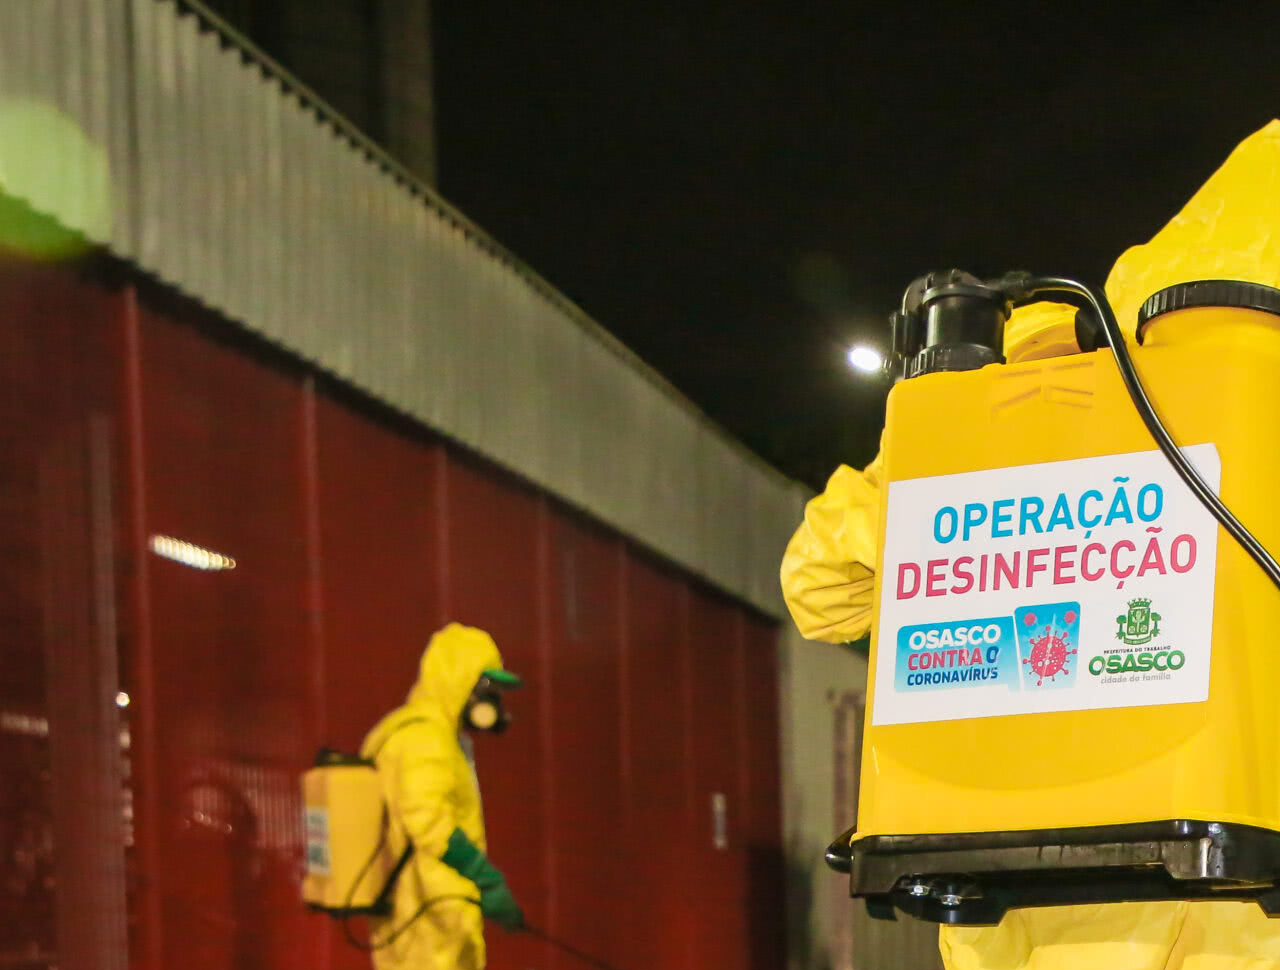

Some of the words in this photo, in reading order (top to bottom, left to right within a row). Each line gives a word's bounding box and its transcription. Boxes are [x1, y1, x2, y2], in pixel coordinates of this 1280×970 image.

[933, 476, 1164, 544] OPERAÇÃO
[896, 526, 1197, 601] DESINFECÇÃO
[909, 624, 1001, 650] OSASCO
[908, 647, 983, 671] CONTRA
[986, 645, 999, 664] O
[1088, 650, 1186, 676] OSASCO
[907, 666, 999, 686] CORONAVÍRUS
[1100, 674, 1127, 685] cidade
[1129, 673, 1140, 682] da
